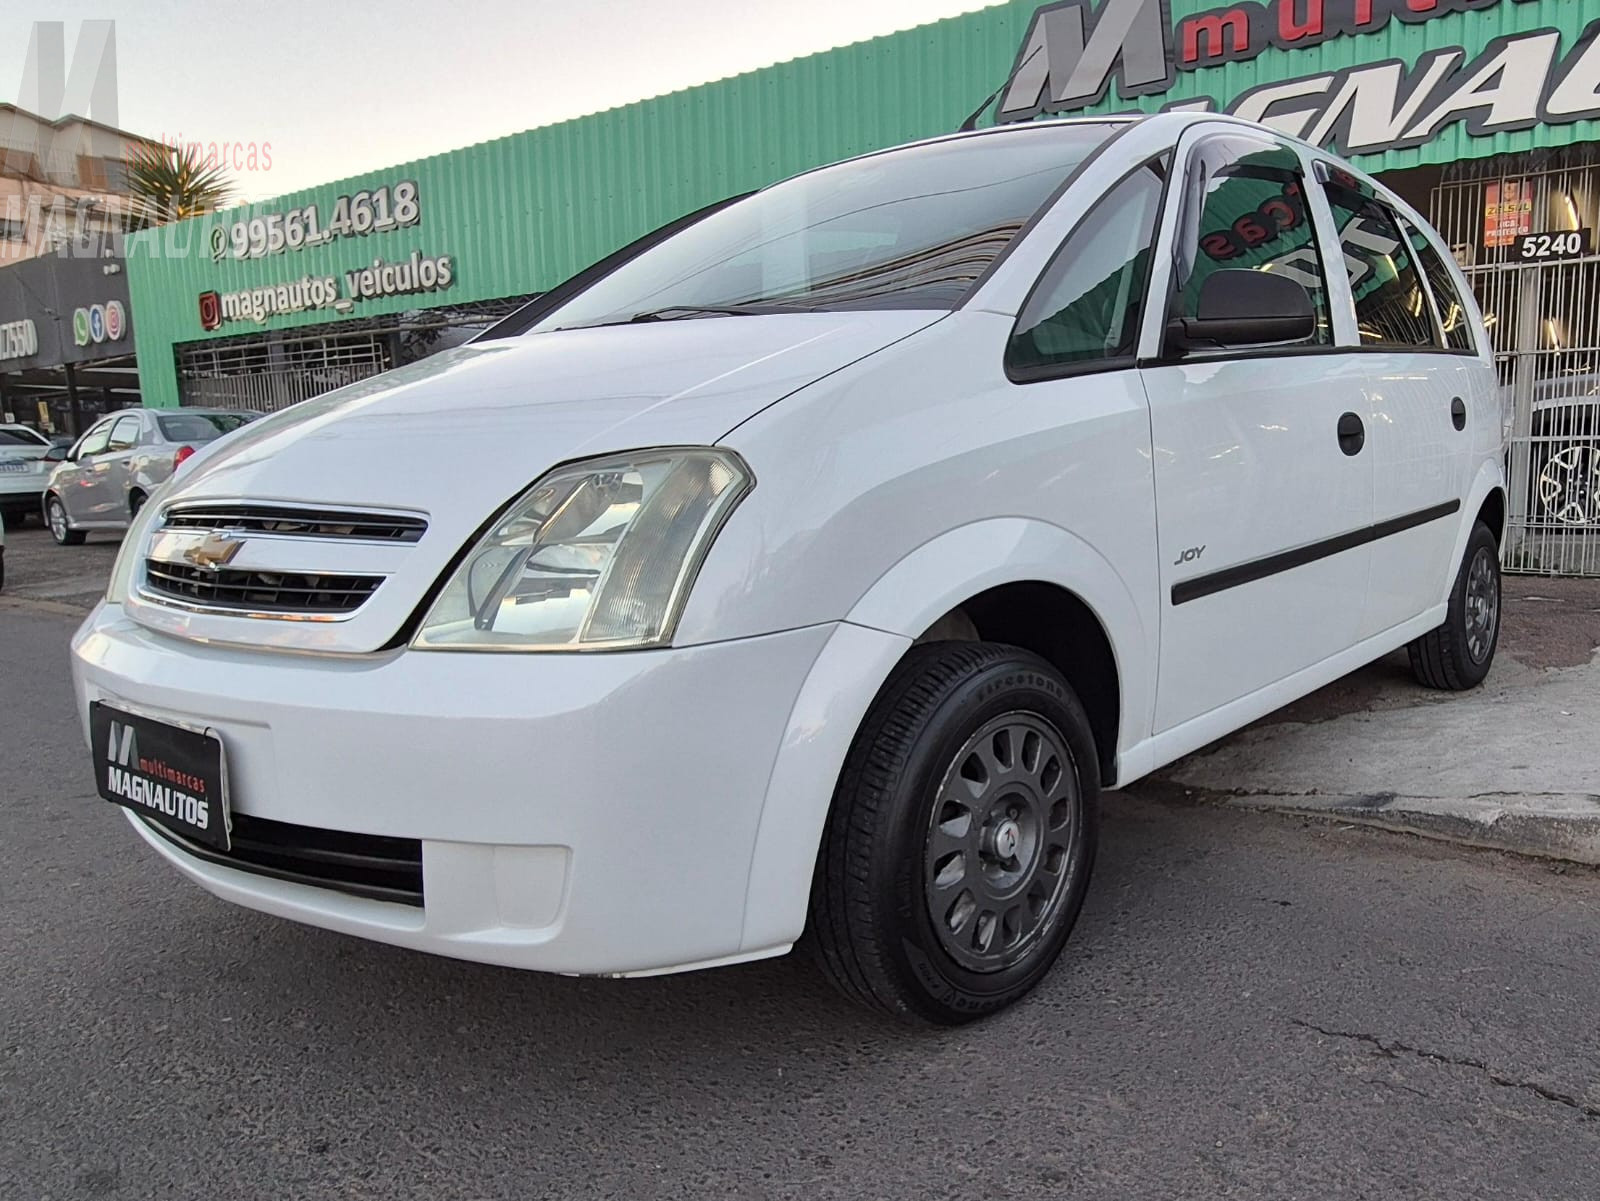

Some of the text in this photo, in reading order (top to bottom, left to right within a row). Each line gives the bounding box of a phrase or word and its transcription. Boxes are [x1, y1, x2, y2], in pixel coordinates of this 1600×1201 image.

[1183, 0, 1436, 62] mu
[231, 181, 420, 259] 99561.4618
[1521, 233, 1581, 258] 5240
[221, 250, 452, 324] magnautos_veiculos
[1174, 544, 1206, 566] JOY
[107, 766, 209, 830] MAGNAUTOS
[139, 757, 206, 793] multimarcas
